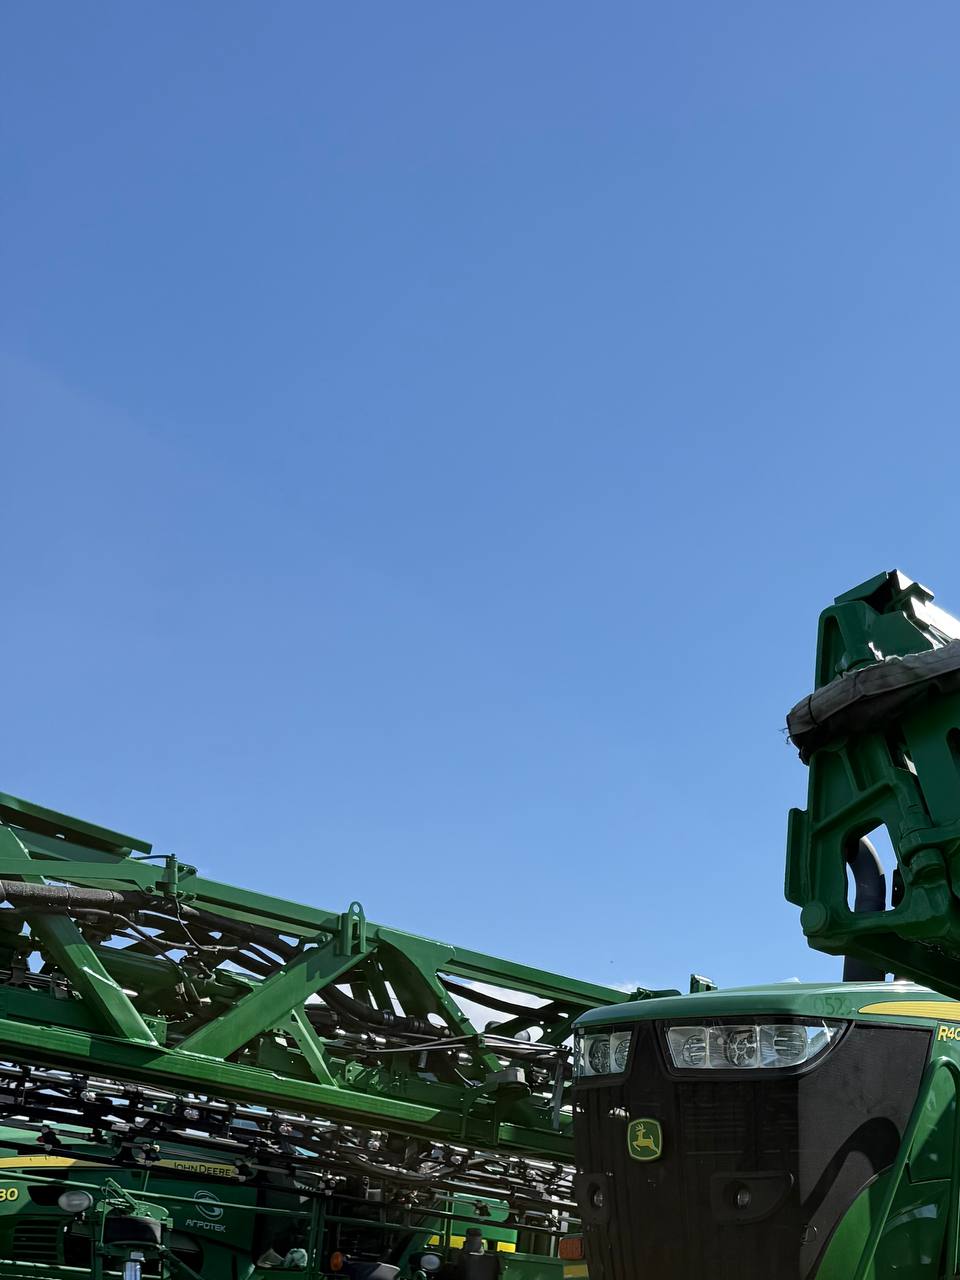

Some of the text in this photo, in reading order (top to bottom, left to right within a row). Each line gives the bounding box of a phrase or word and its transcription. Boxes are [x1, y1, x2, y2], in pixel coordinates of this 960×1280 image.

[174, 1162, 232, 1177] JOHN DEERE
[185, 1219, 226, 1233] АГРОТЕК
